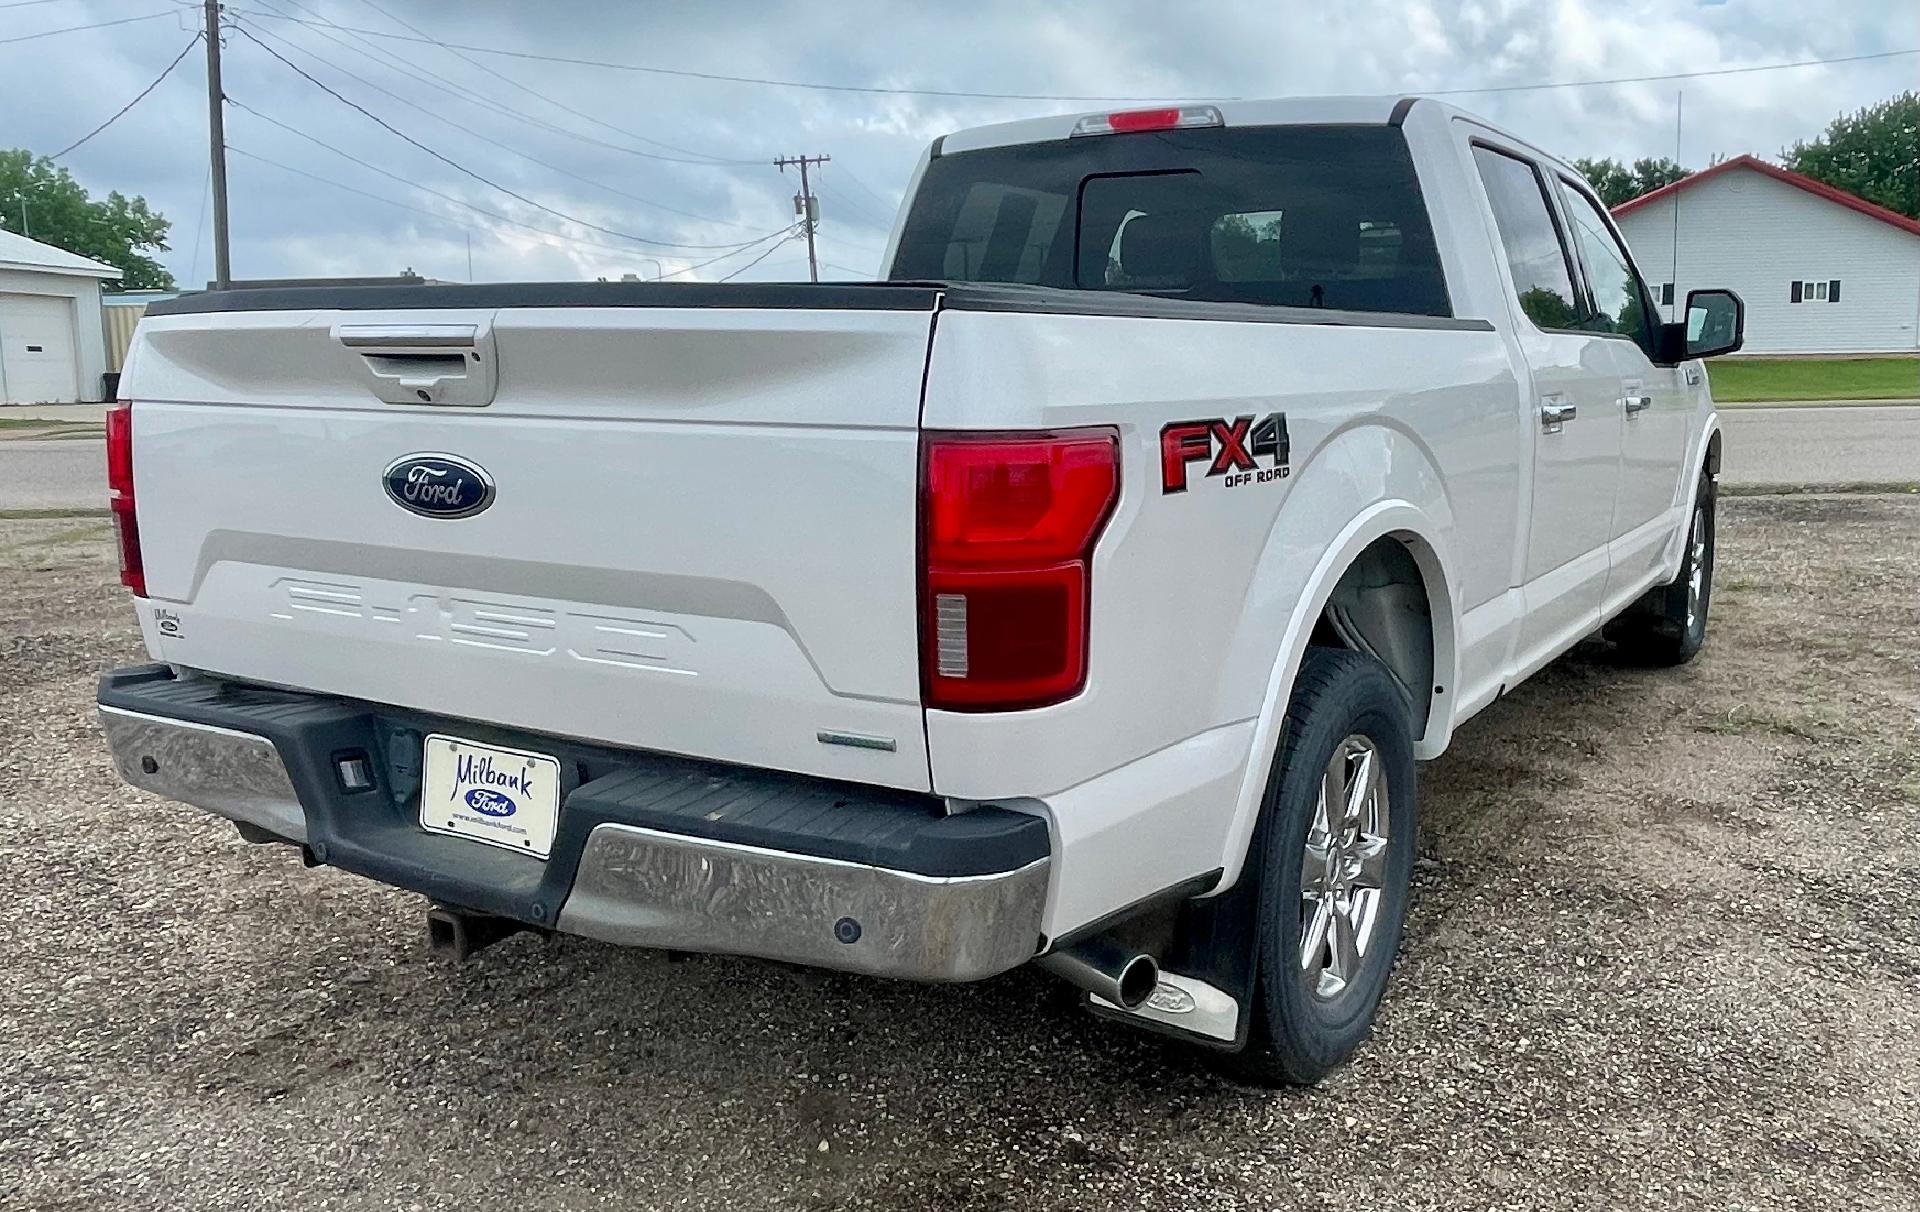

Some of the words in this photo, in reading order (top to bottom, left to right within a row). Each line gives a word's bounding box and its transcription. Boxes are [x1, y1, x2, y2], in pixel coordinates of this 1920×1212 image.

[1159, 411, 1290, 496] FX4
[404, 465, 464, 505] Ford
[1224, 474, 1251, 488] OFF
[1256, 466, 1290, 484] ROAD
[269, 576, 698, 677] F-150
[450, 754, 533, 802] Milbank
[470, 790, 509, 815] Ford
